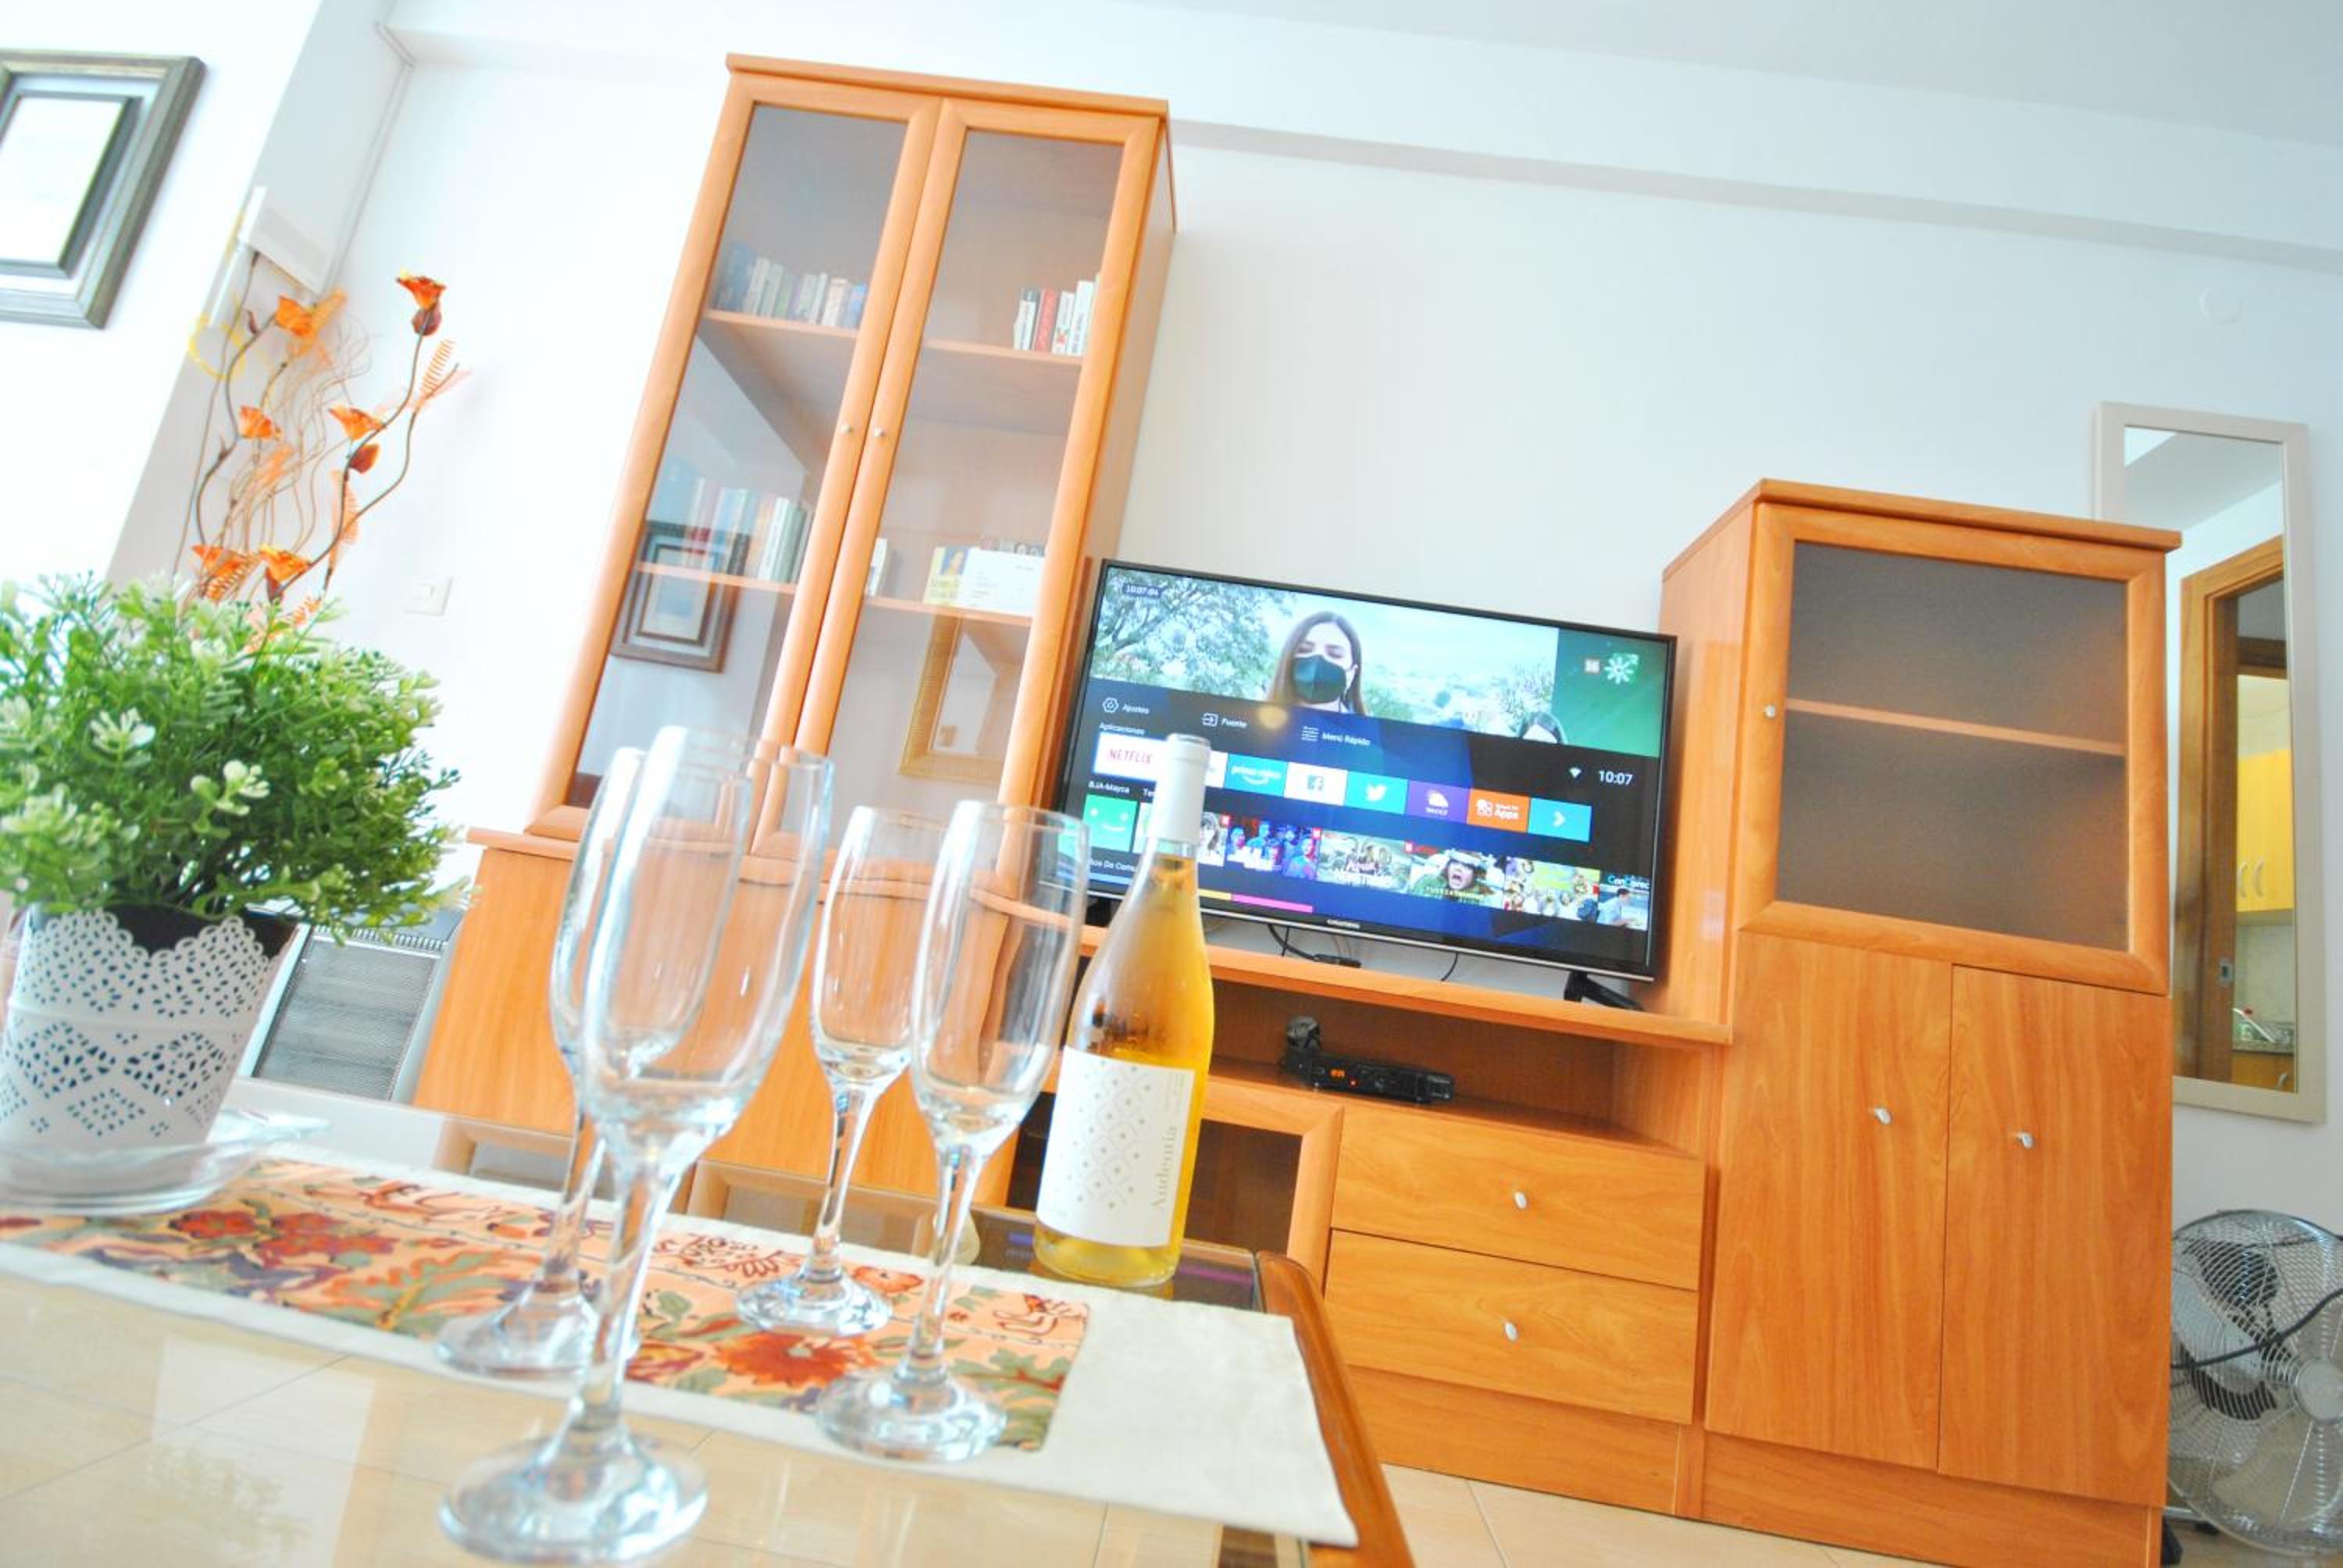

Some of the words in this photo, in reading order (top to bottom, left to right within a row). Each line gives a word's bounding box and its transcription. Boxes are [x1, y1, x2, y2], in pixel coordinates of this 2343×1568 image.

[1121, 704, 1150, 715] Ajustes
[1099, 722, 1146, 735] Aplicaciones
[1221, 717, 1247, 728] Fuente
[1109, 748, 1153, 764] NETFLIX
[1598, 769, 1634, 786] 10:07
